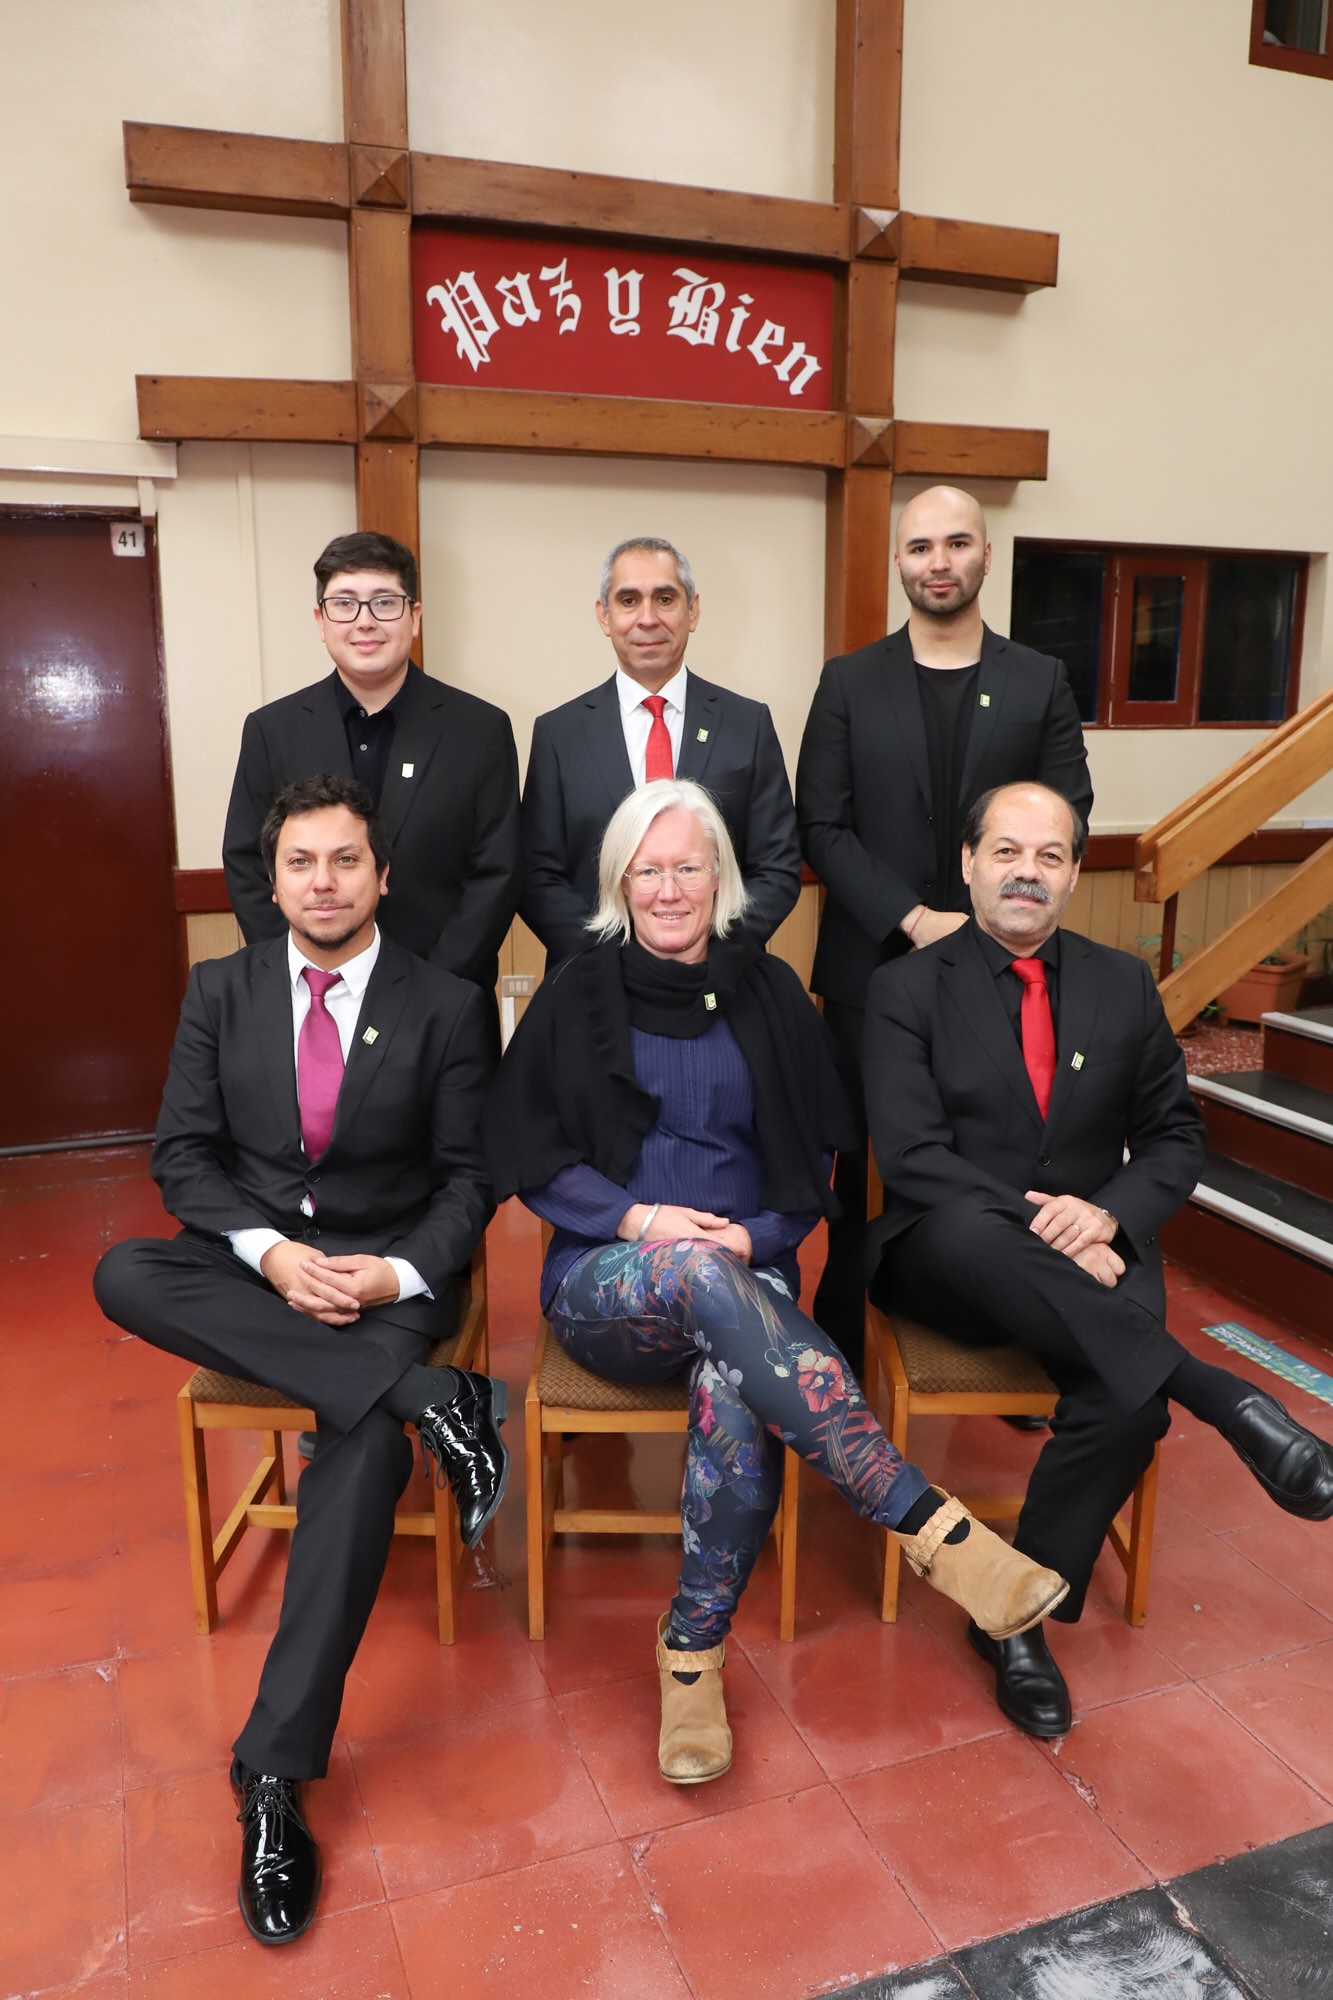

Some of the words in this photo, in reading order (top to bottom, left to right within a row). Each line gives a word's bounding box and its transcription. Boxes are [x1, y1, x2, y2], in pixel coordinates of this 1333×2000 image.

[426, 258, 582, 372] Paz
[666, 268, 821, 395] Bien
[118, 530, 136, 548] 41
[1213, 1326, 1272, 1361] DISTANCIA
